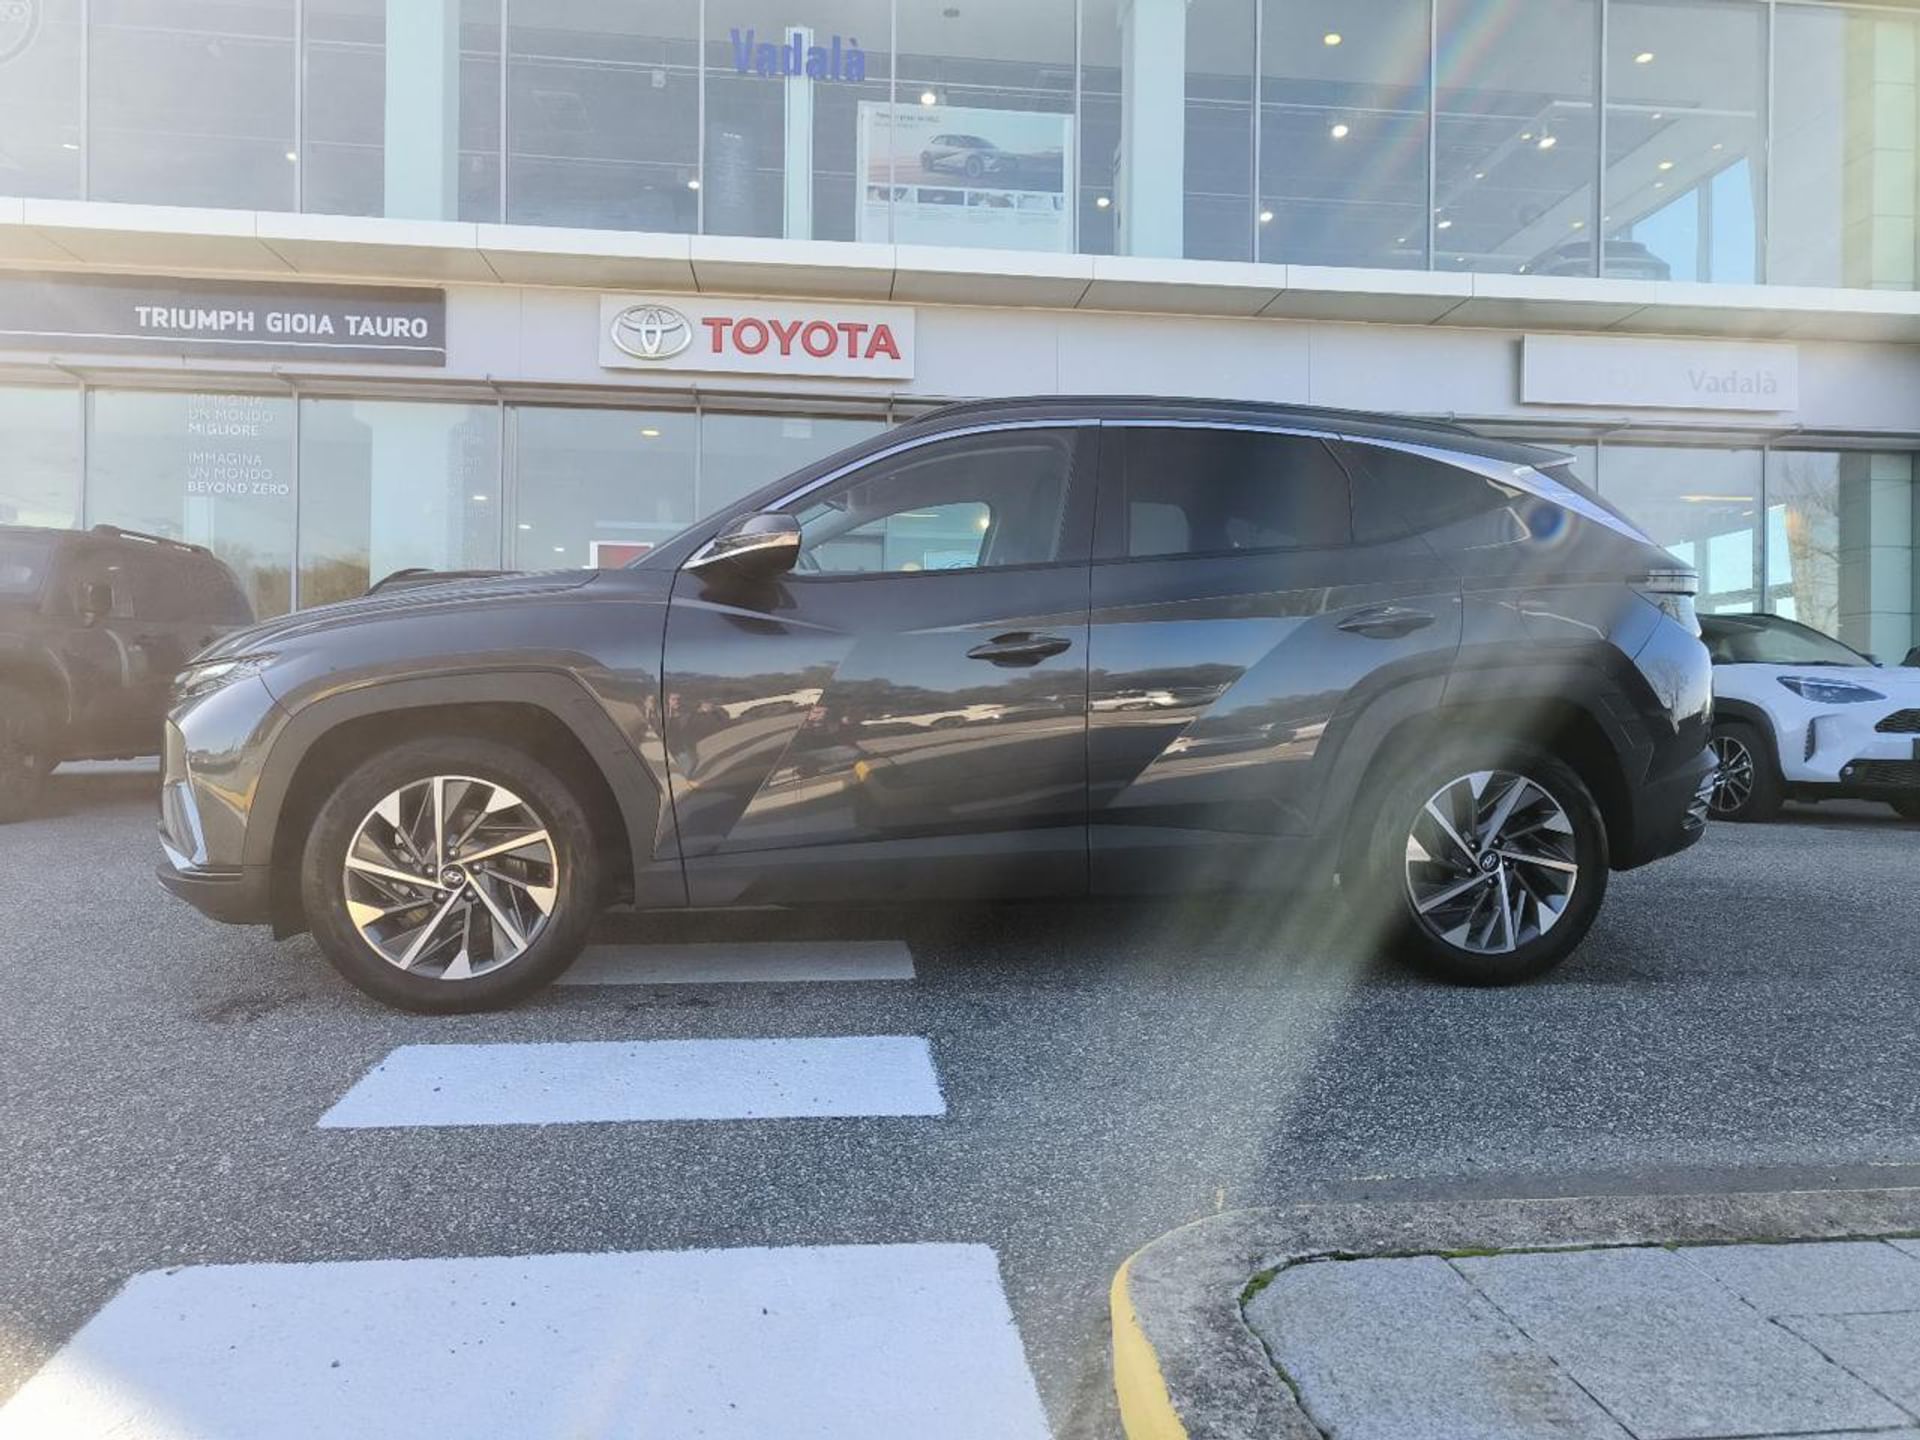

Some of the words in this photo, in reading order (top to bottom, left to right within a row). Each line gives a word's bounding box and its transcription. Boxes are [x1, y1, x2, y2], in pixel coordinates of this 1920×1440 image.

[729, 27, 865, 82] Vadalà
[135, 305, 254, 332] TRIUMPH
[266, 311, 335, 335] GIOIA
[345, 315, 429, 339] TAURO
[702, 317, 901, 360] TOYOTA
[1687, 368, 1777, 394] Vadalà
[215, 408, 275, 422] MONDO
[188, 422, 261, 437] MIGLIORE
[187, 452, 263, 467] IMMAGINA
[188, 466, 210, 480] UN
[214, 467, 274, 482] MONDO
[187, 480, 249, 494] BEYOND
[251, 482, 290, 496] ZERO
